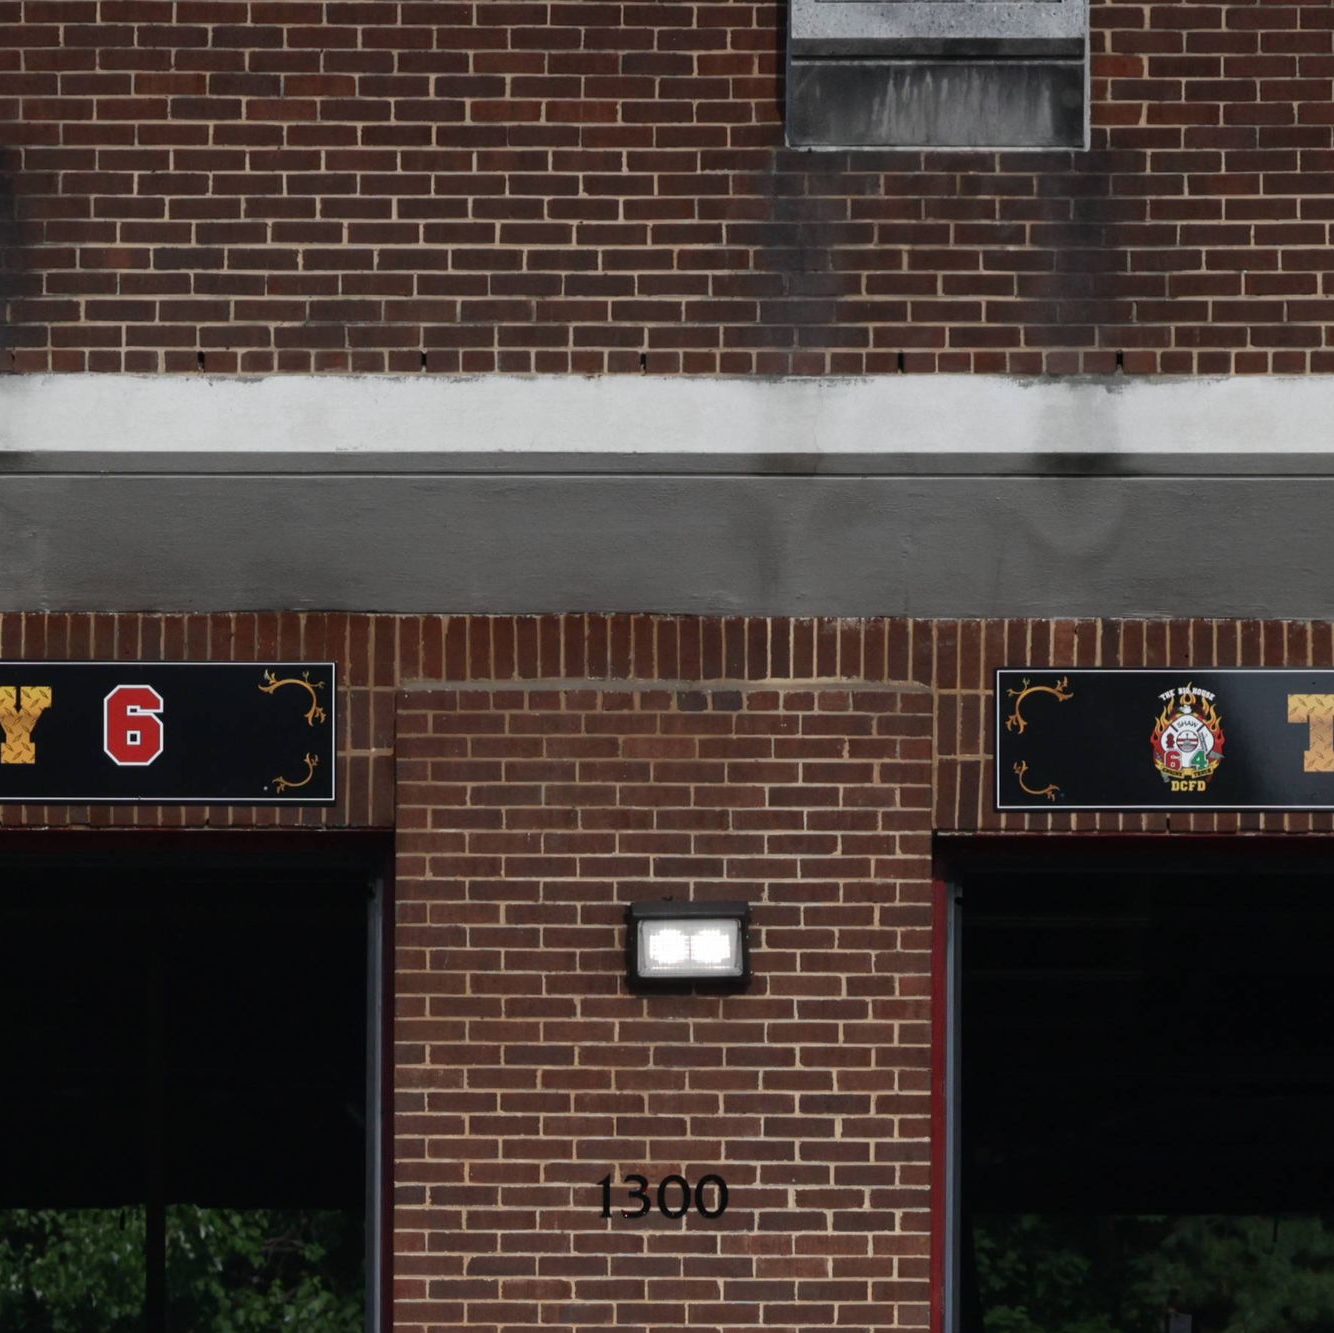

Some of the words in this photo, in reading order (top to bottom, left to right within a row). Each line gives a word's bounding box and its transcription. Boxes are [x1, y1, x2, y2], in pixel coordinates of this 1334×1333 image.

[103, 683, 165, 767] 6
[1170, 780, 1207, 792] DCFD
[595, 1173, 730, 1220] 1300
